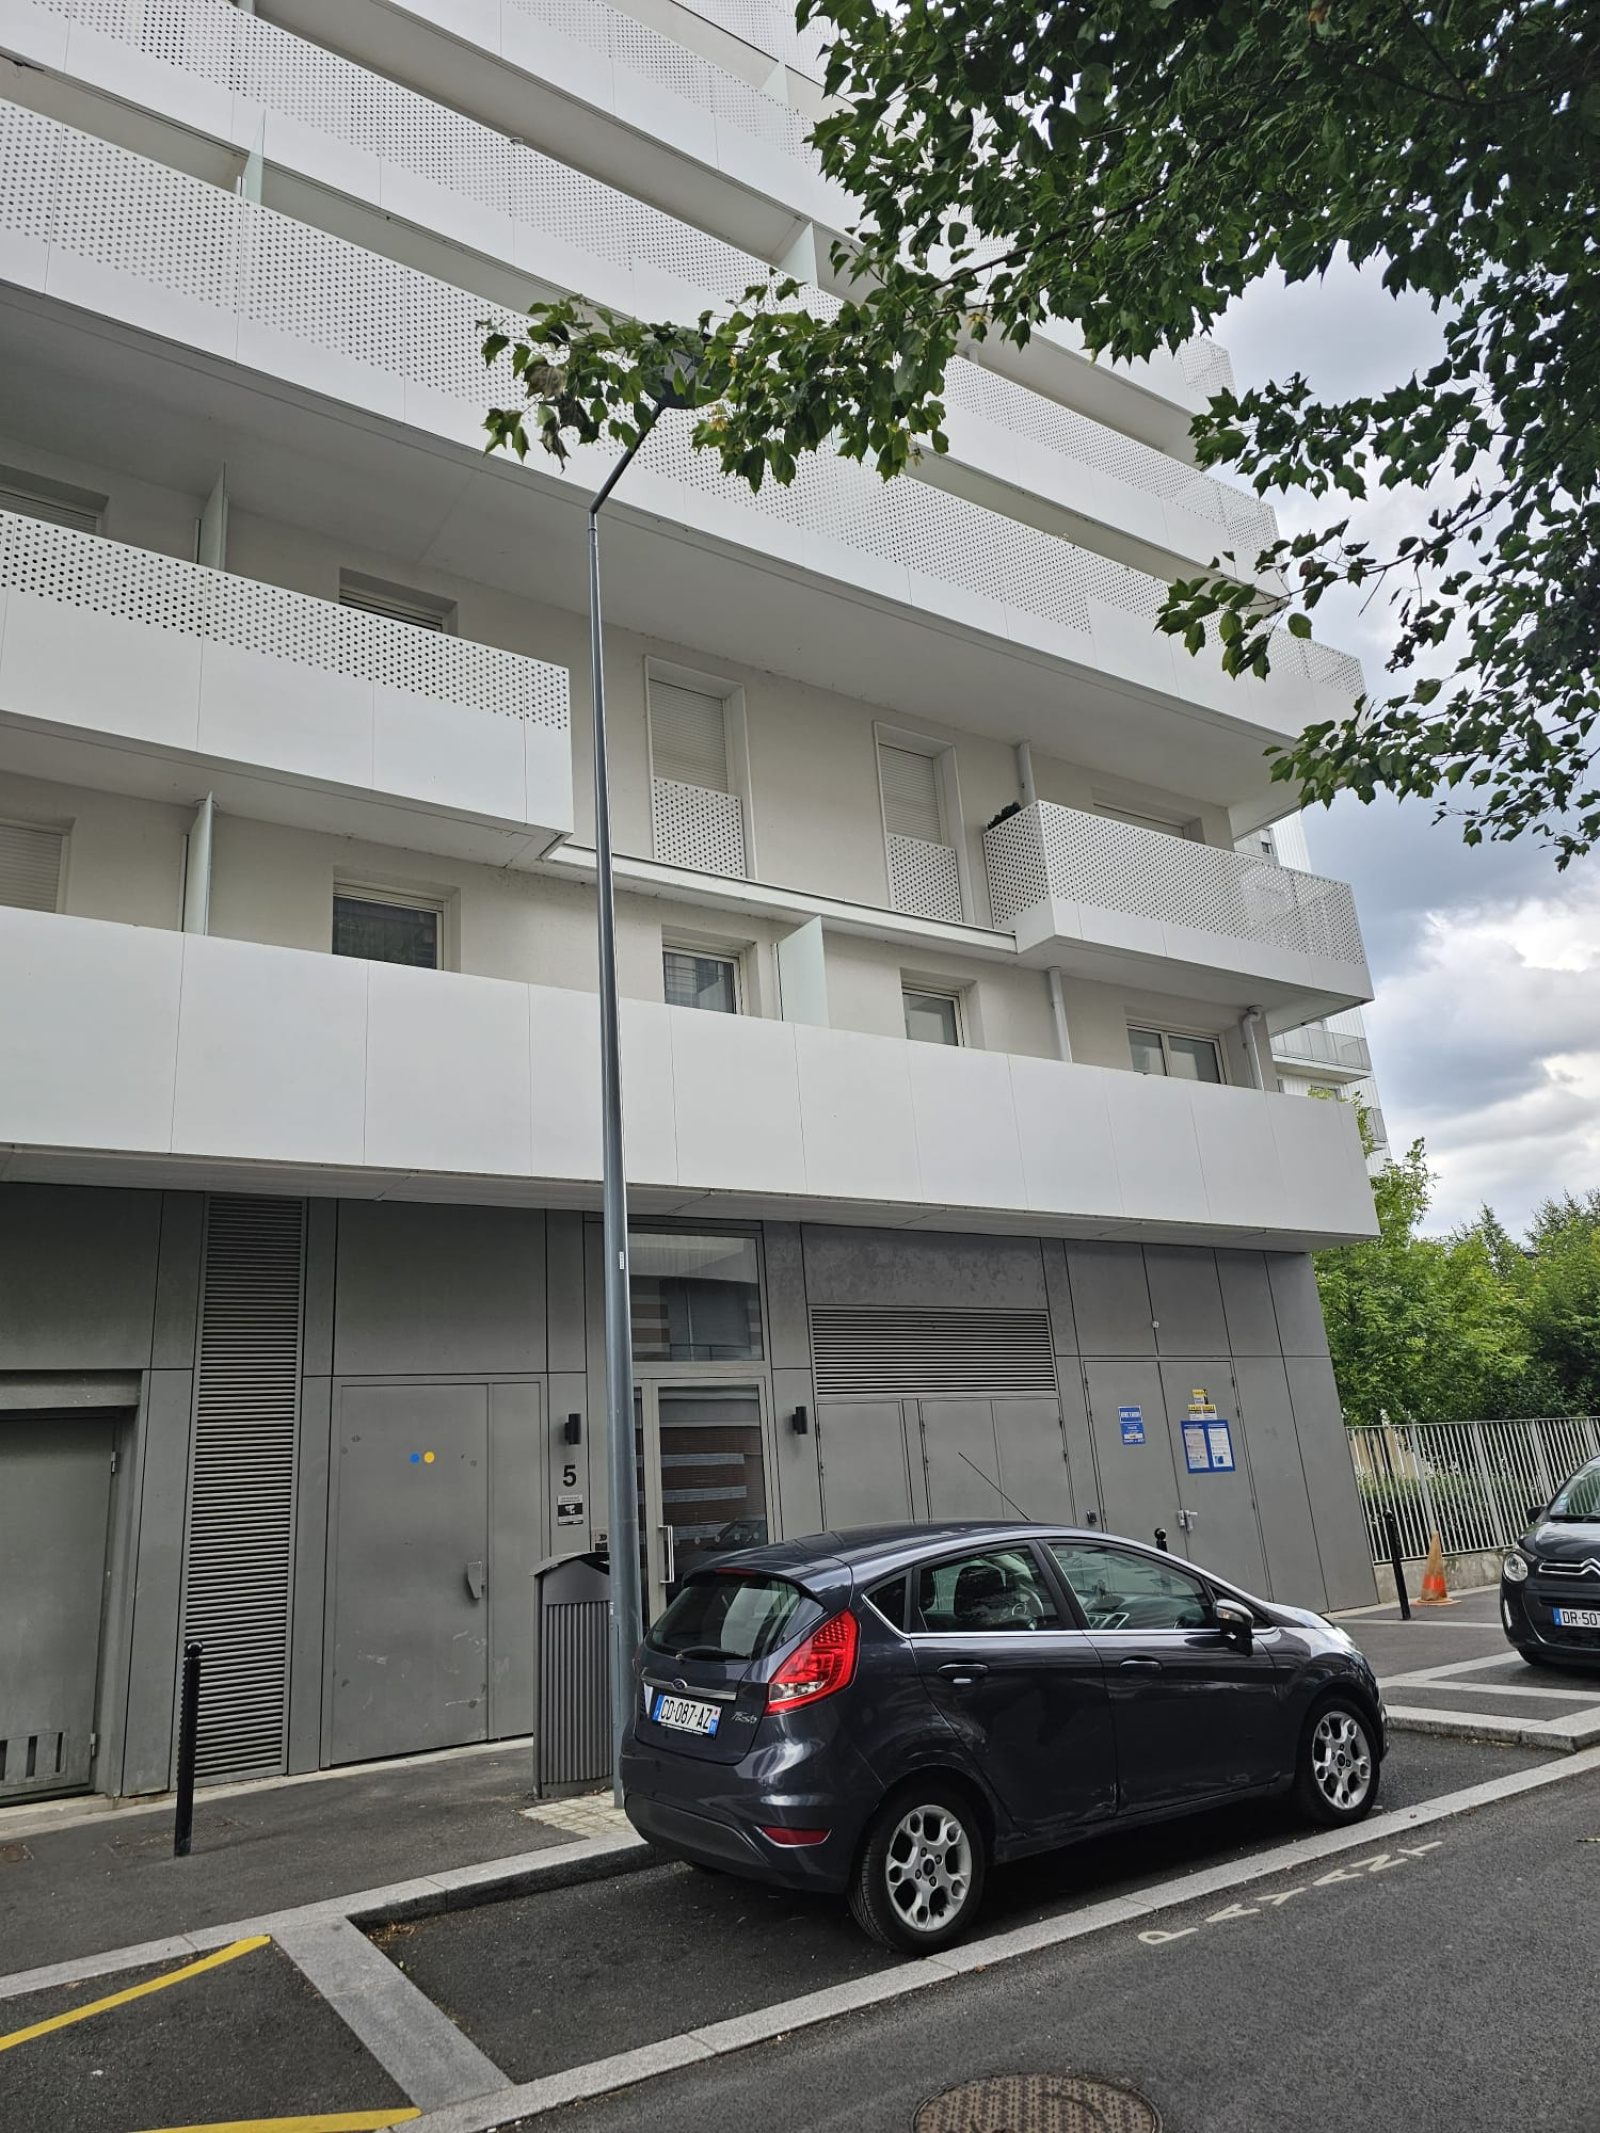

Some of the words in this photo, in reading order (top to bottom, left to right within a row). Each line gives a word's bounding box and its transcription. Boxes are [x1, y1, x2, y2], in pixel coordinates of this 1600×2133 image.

[563, 1465, 577, 1487] 5
[661, 1699, 712, 1729] CD-087-AZ
[1137, 1840, 1443, 1945] PAYANT
